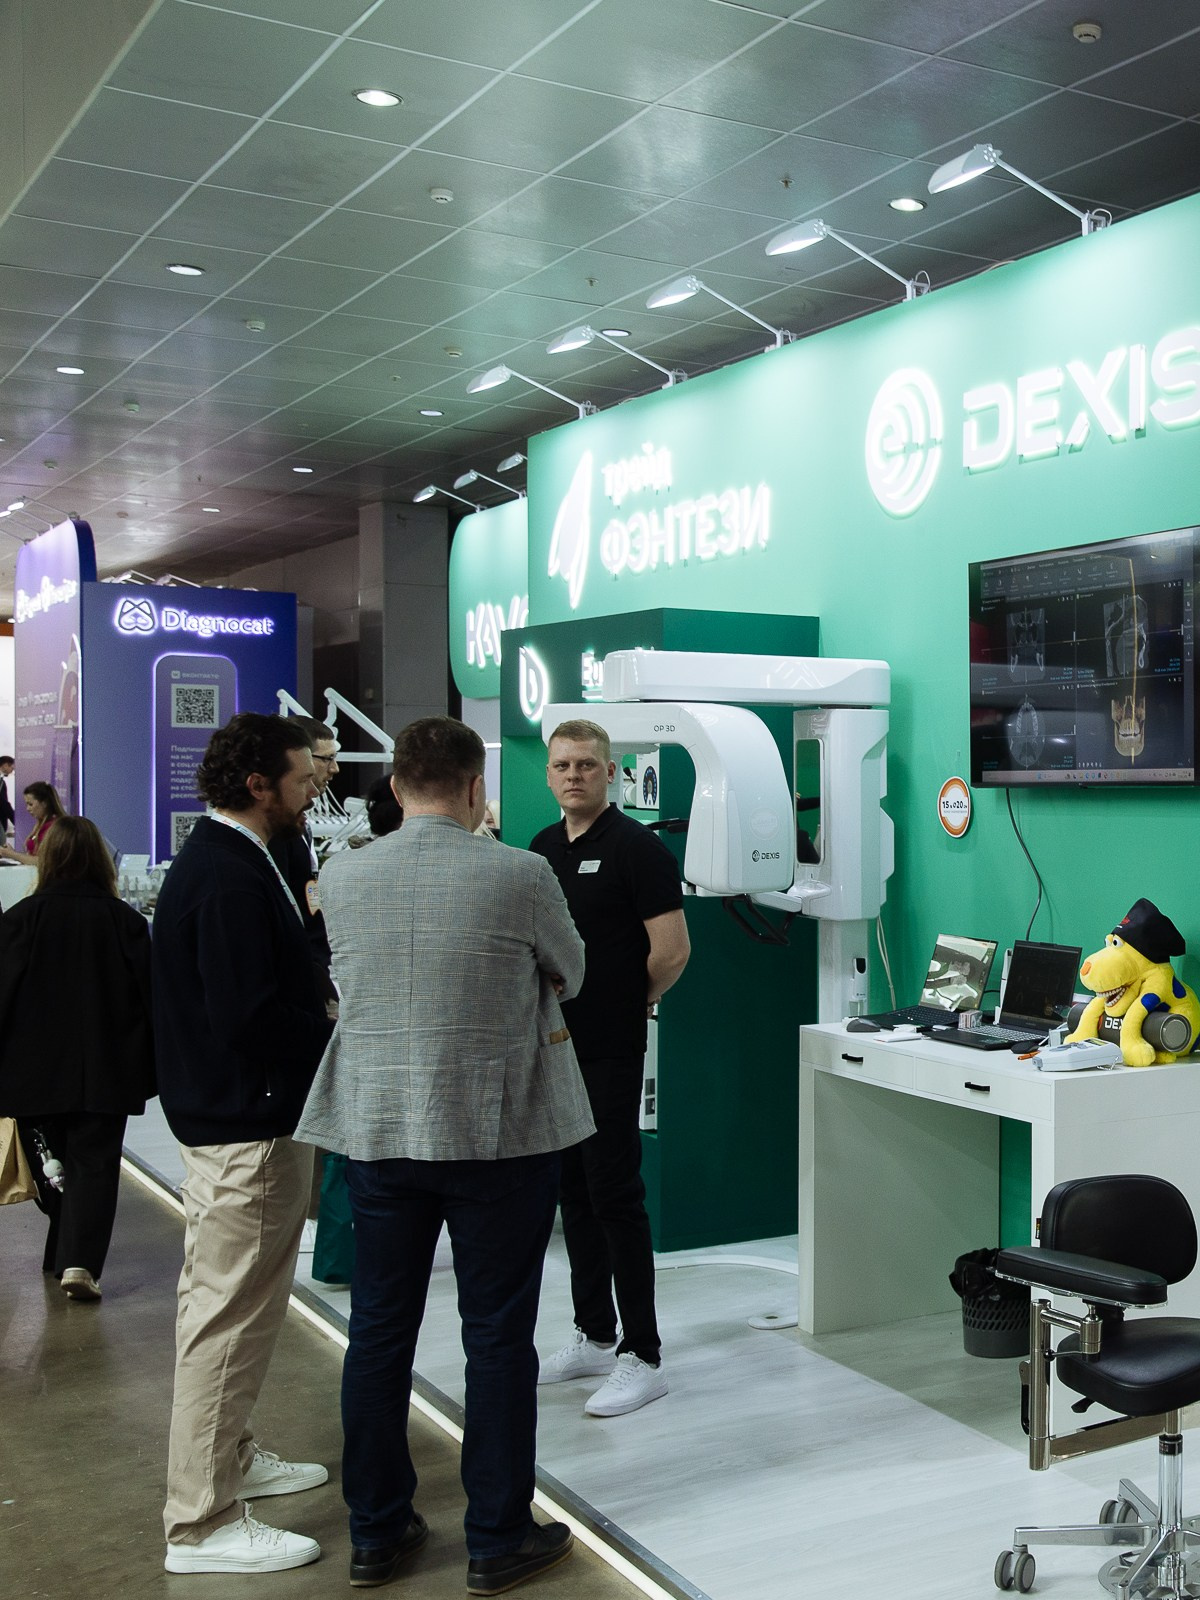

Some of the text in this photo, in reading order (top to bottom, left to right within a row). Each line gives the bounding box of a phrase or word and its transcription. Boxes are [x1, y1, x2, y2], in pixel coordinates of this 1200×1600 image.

[600, 482, 770, 575] ФЭНТЕЗИ
[161, 607, 275, 637] Diagnocat
[761, 852, 780, 860] DEXIS
